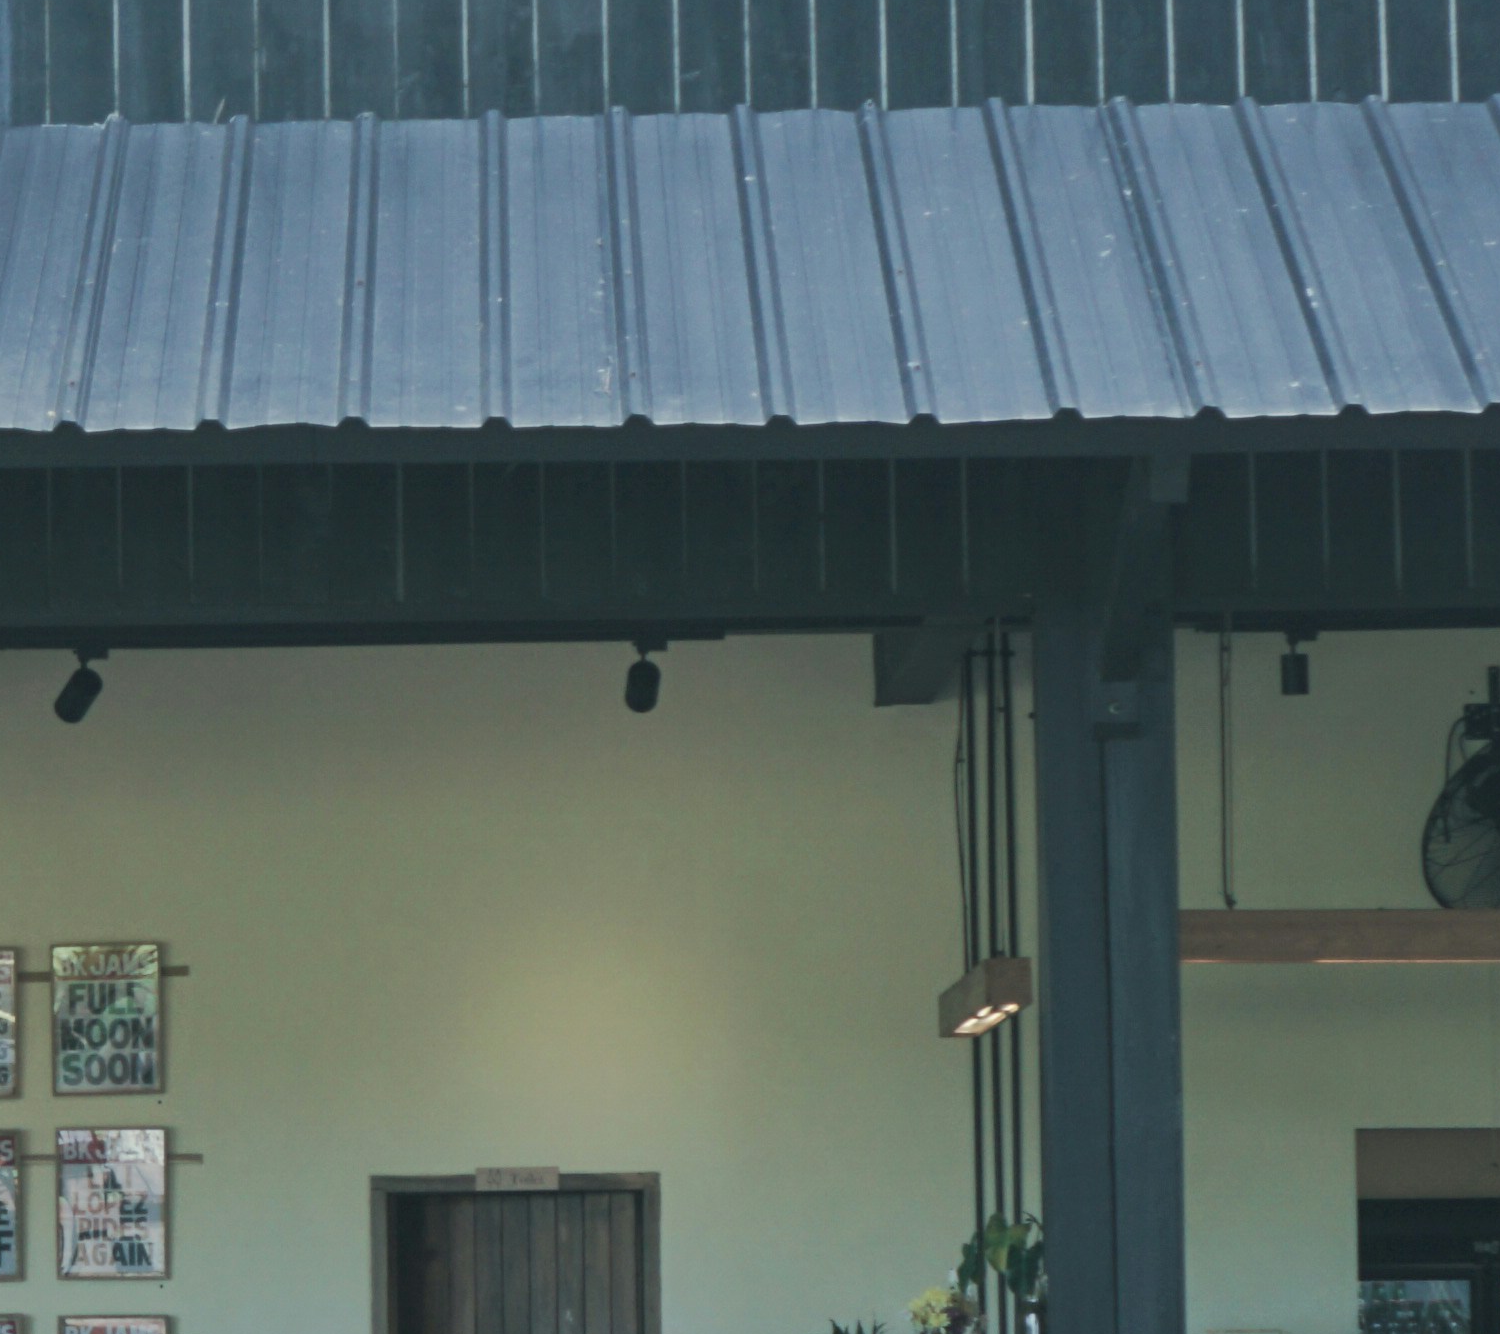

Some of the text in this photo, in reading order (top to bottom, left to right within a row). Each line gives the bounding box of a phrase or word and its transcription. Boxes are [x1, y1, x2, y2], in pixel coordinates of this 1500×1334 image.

[69, 982, 139, 1014] FULL
[61, 1018, 153, 1049] MOON
[62, 1052, 153, 1085] SOON
[73, 1191, 148, 1214] LOPEZ
[78, 1218, 147, 1241] RIDES
[77, 1242, 153, 1266] AGAIN
